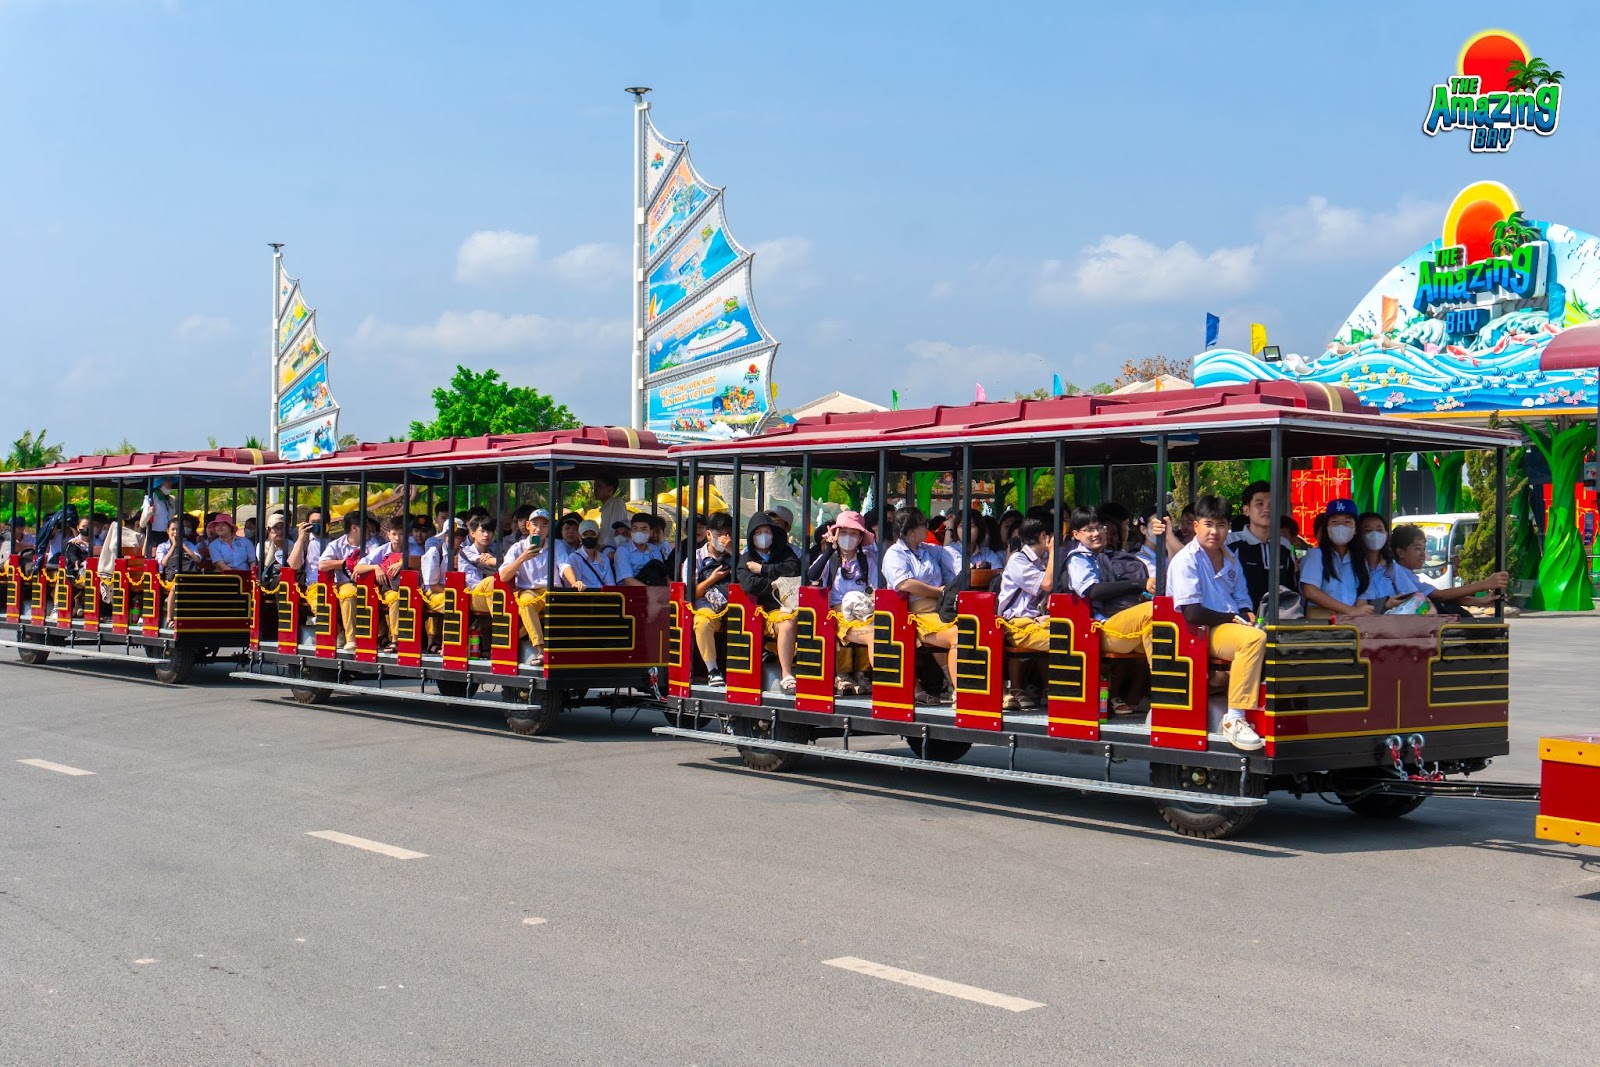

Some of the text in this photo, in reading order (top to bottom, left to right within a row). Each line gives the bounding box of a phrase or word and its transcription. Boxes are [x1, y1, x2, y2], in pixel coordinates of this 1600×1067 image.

[1434, 247, 1459, 268] THE
[1413, 245, 1535, 310] Amazing
[1446, 309, 1478, 334] BAY
